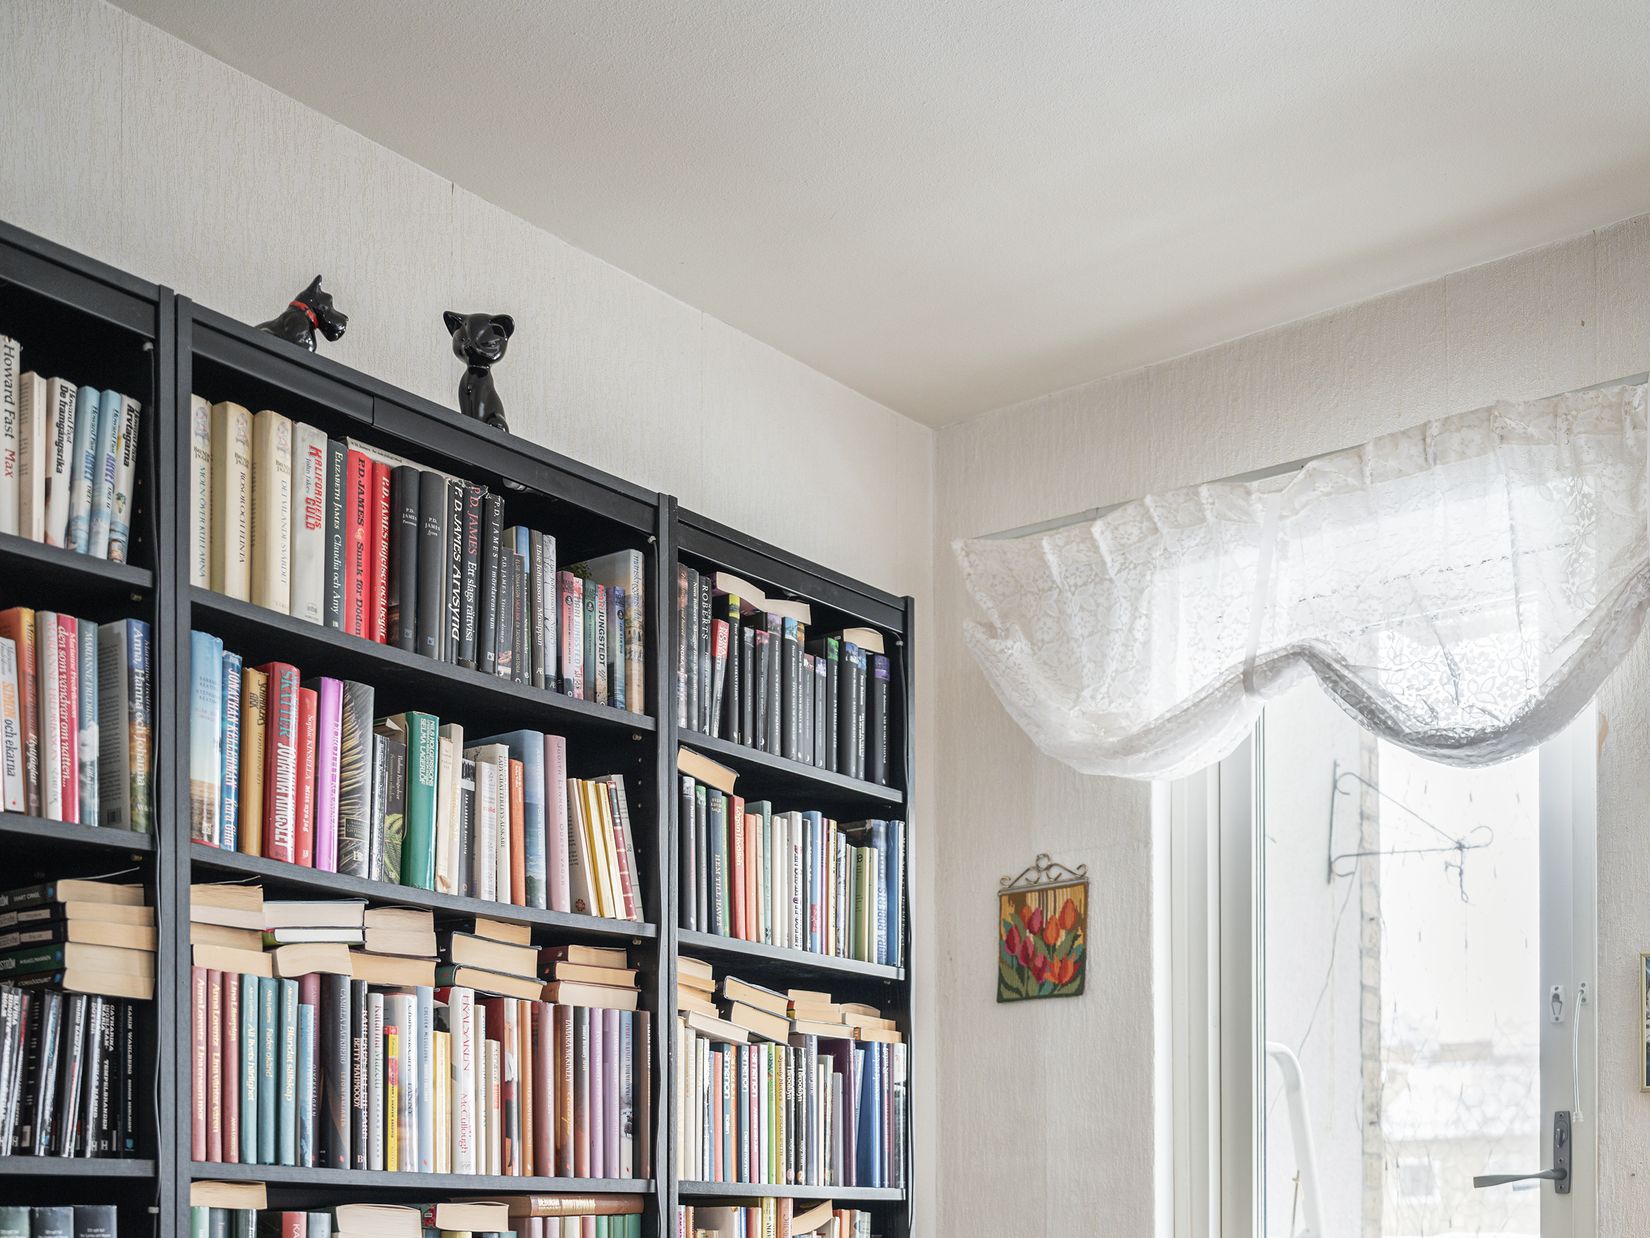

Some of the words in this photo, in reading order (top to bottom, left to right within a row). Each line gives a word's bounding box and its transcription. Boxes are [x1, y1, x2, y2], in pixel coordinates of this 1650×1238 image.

[4, 344, 15, 404] Howard
[60, 385, 68, 398] De
[4, 408, 15, 439] Fast
[56, 400, 68, 474] framgångsrika
[123, 404, 135, 467] Arvtagarna
[5, 448, 16, 477] Max
[333, 534, 341, 570] Claudia
[467, 560, 477, 577] Ett
[333, 572, 341, 588] och
[465, 578, 477, 602] slags
[331, 592, 340, 614] Amy
[449, 564, 461, 641] Arvsynd
[465, 604, 476, 641] rättvisa
[134, 628, 143, 664] Anna,
[135, 668, 144, 709] Hanna
[226, 668, 240, 723] JONATHAN
[135, 712, 144, 732] och
[135, 735, 145, 786] Johanna
[226, 725, 238, 788] KELLERMAN
[286, 1026, 295, 1062] Blandat
